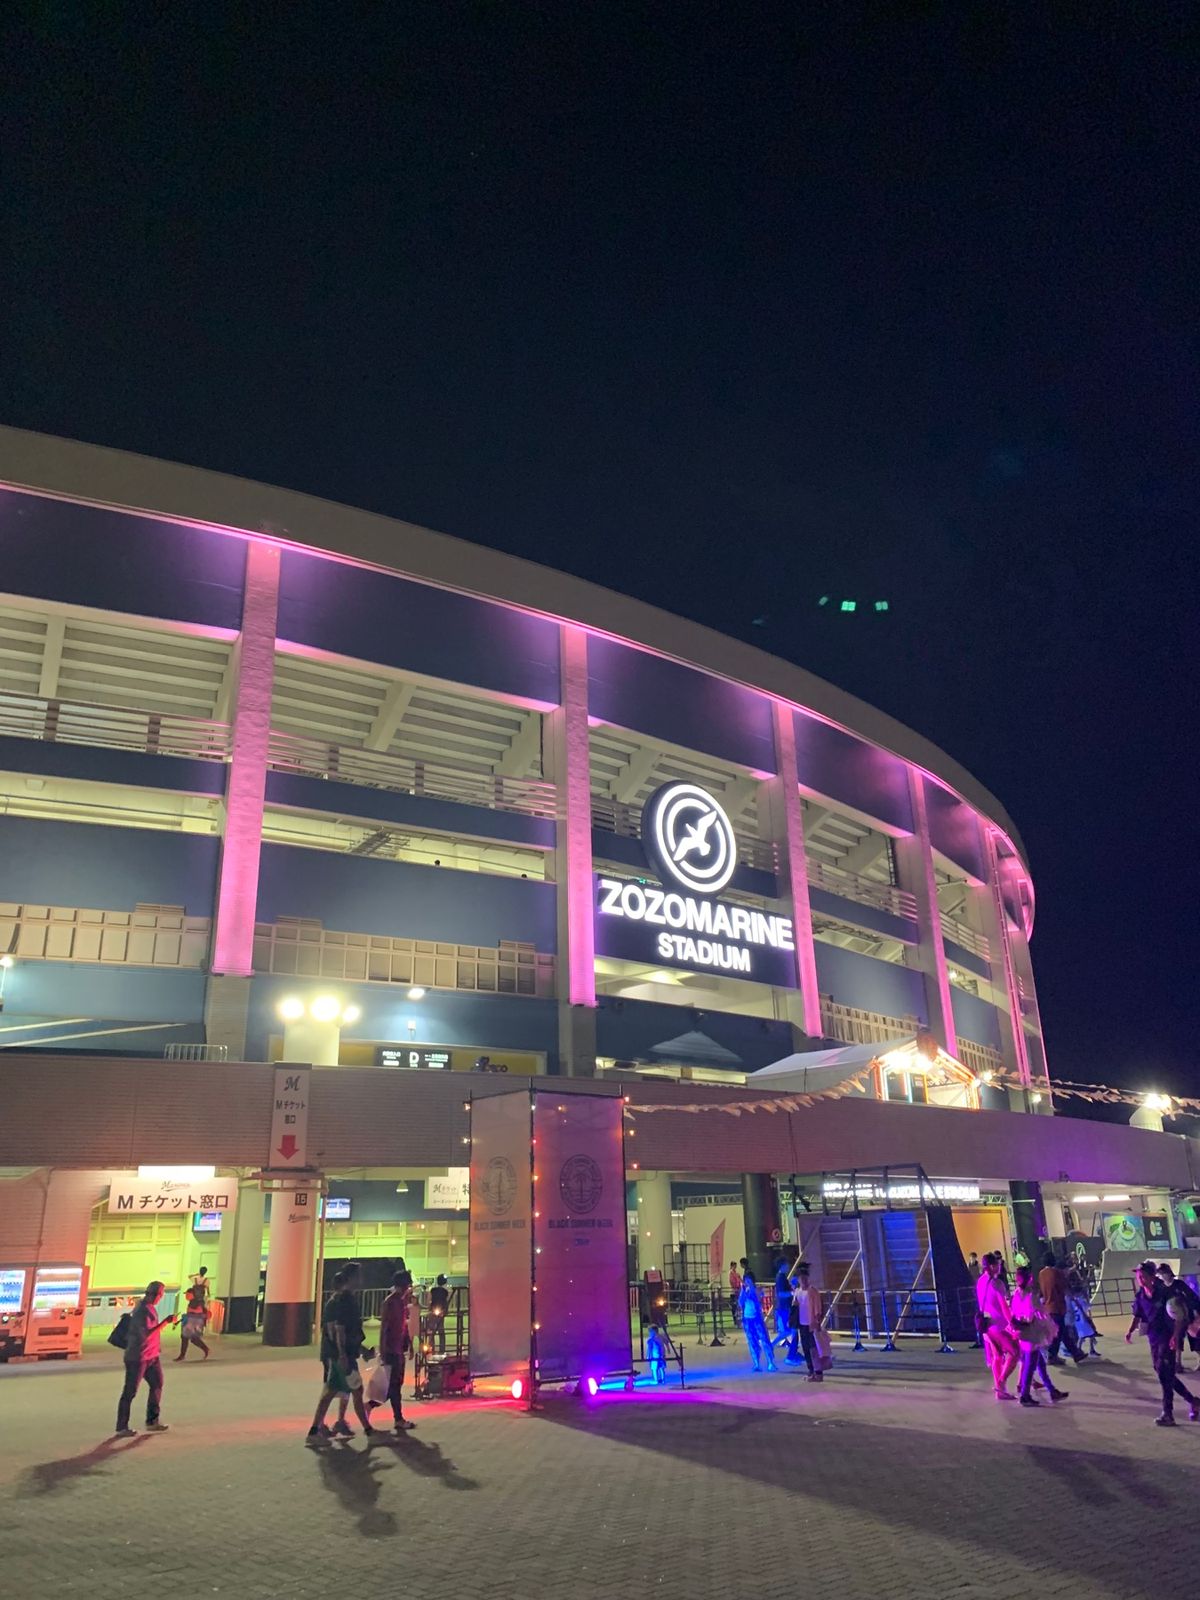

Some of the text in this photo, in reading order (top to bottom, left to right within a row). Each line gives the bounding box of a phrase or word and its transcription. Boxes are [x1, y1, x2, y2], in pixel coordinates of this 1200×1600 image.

[601, 879, 795, 951] ZOZOMARINE
[658, 932, 751, 972] STADIUM
[409, 1051, 420, 1064] D
